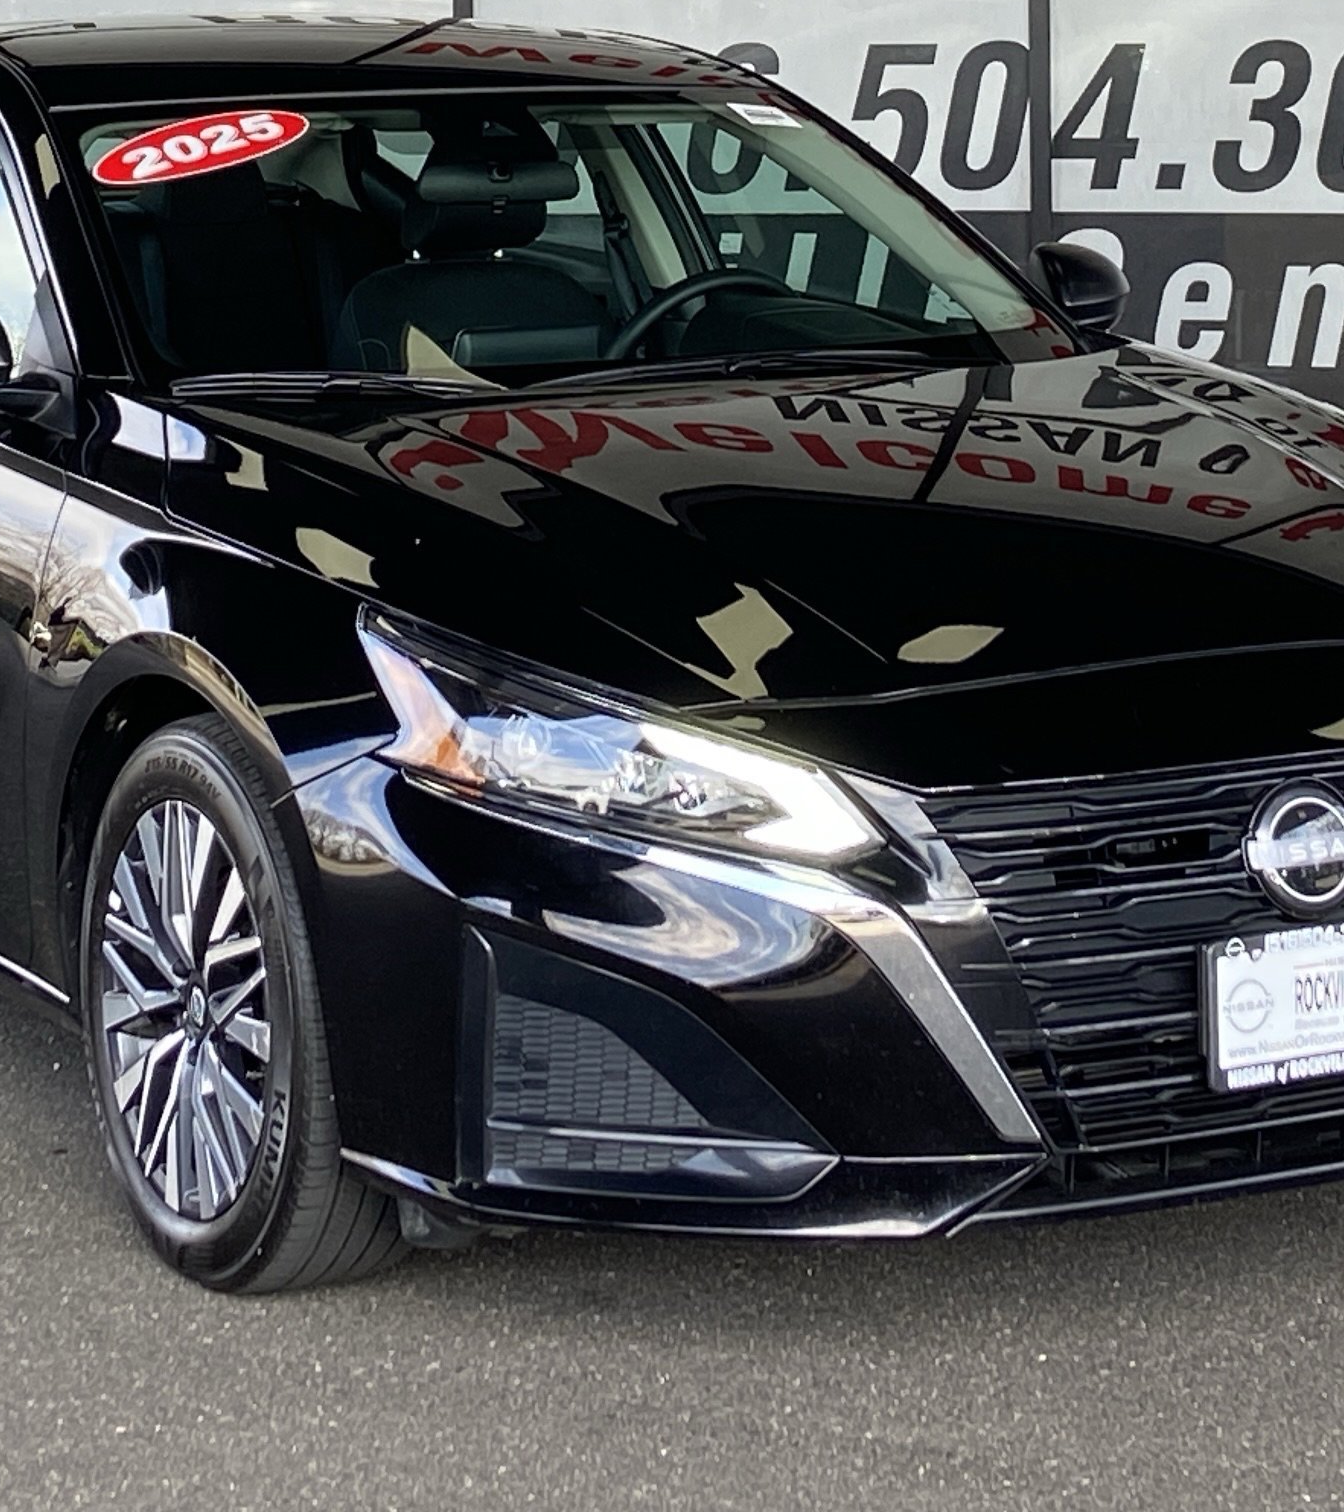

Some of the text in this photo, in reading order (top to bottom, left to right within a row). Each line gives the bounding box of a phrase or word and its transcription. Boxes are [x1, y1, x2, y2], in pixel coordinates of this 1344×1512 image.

[121, 112, 286, 180] 2025
[1223, 998, 1274, 1014] NISSAN
[1227, 1063, 1275, 1089] NISSAN
